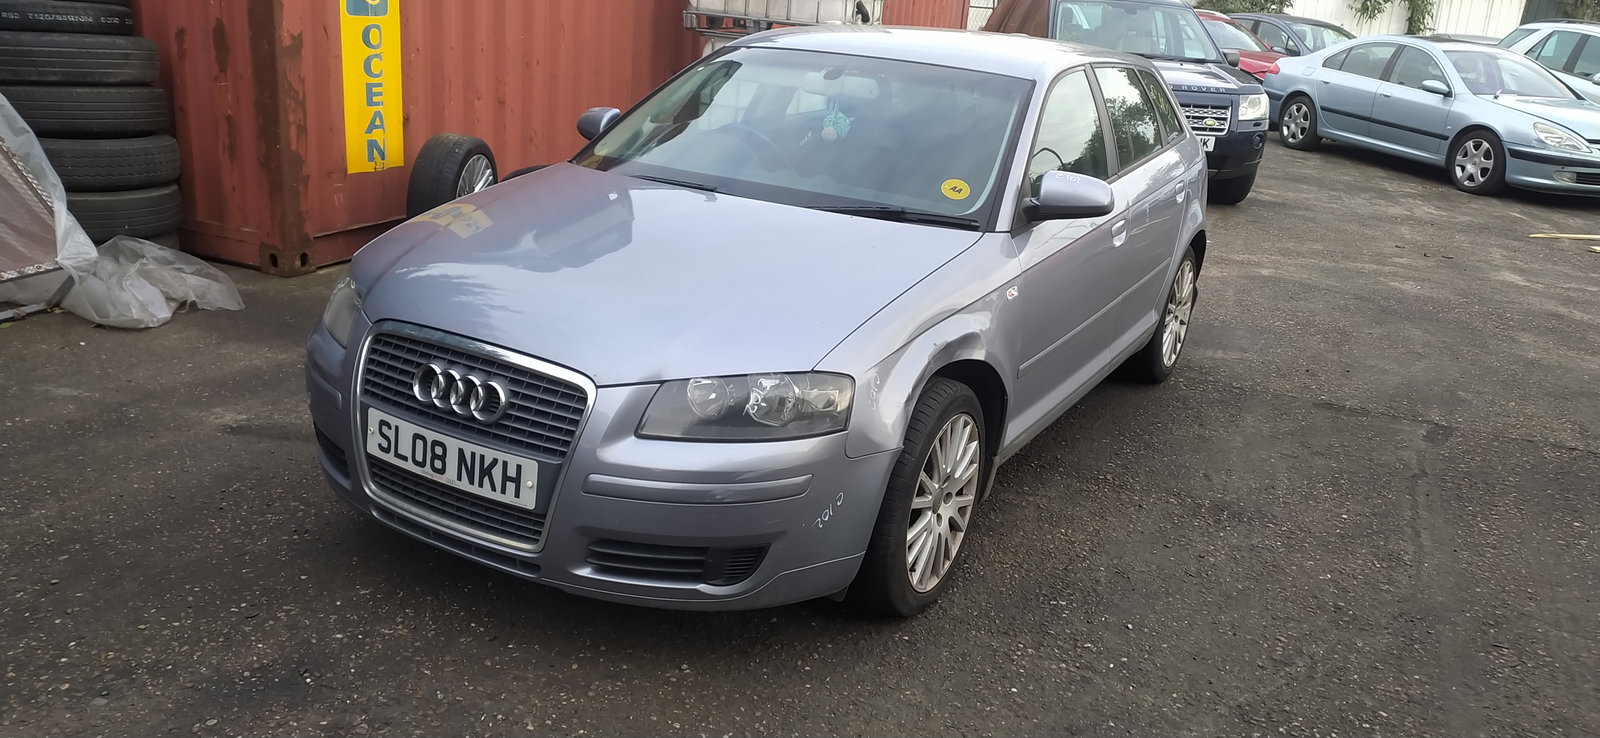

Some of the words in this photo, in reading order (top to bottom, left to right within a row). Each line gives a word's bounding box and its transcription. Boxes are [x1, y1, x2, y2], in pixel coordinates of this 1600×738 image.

[361, 23, 387, 163] OCEAN
[949, 186, 963, 194] AA
[378, 418, 448, 476] SL08
[456, 447, 523, 499] NKH
